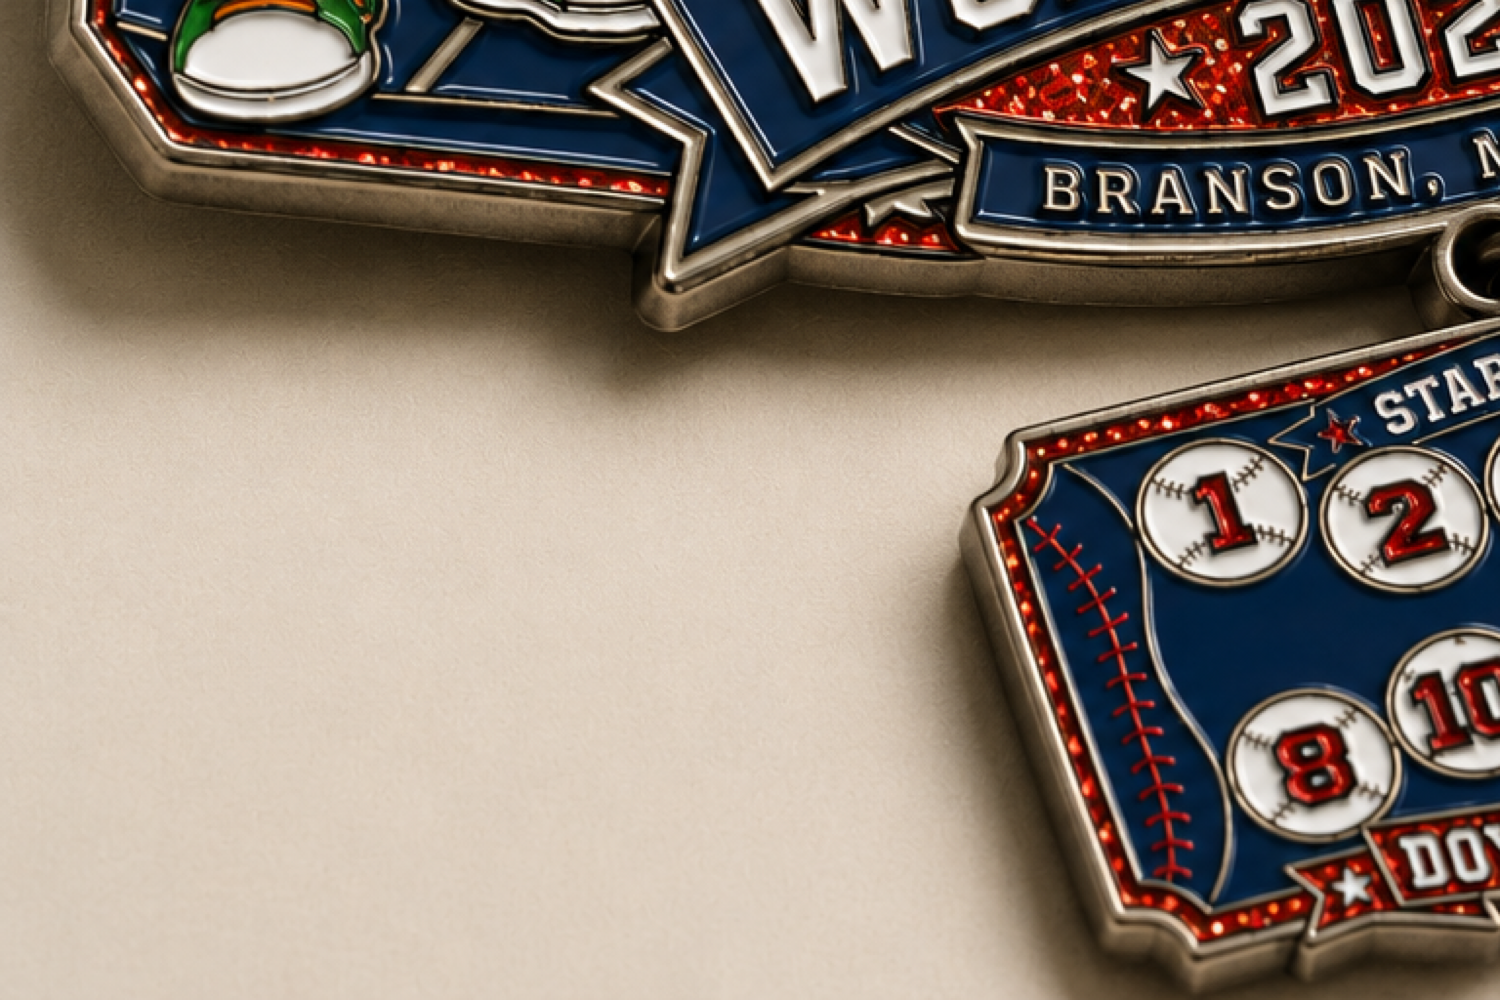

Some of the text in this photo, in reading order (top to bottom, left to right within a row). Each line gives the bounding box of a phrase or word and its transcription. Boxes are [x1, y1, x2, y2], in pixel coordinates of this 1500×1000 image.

[1042, 153, 1443, 217] BRANSON,
[1193, 471, 1257, 555] 1
[1366, 479, 1450, 567] 2
[1273, 723, 1357, 806] 8
